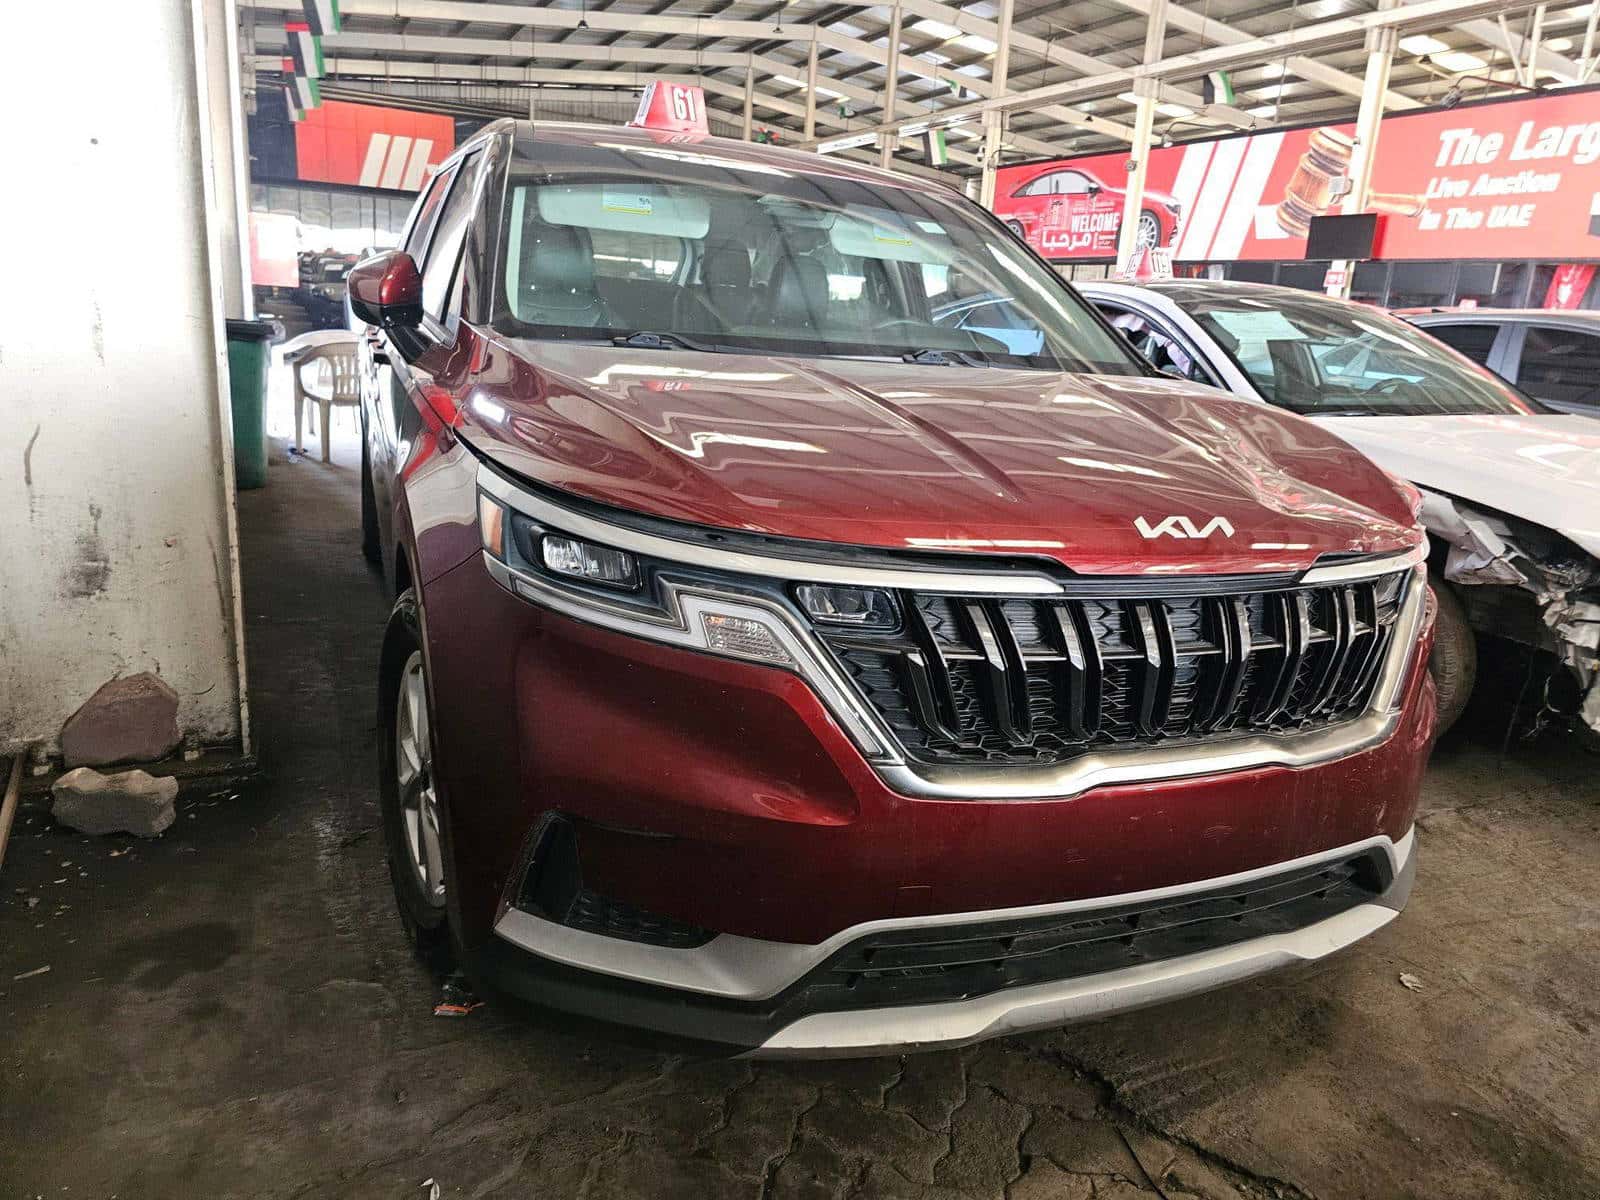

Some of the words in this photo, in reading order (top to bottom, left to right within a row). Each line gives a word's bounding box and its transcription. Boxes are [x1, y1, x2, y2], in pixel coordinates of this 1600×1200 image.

[673, 87, 696, 121] 61
[1435, 127, 1504, 167] The
[1509, 120, 1600, 164] Larg
[1426, 177, 1470, 199] Live
[1470, 170, 1561, 196] Auction
[1071, 212, 1120, 233] WELCOME
[1418, 209, 1442, 230] In
[1445, 207, 1484, 229] The
[1486, 204, 1536, 228] UAE
[1042, 231, 1092, 252] مرحبا
[1133, 515, 1235, 539] KIA
